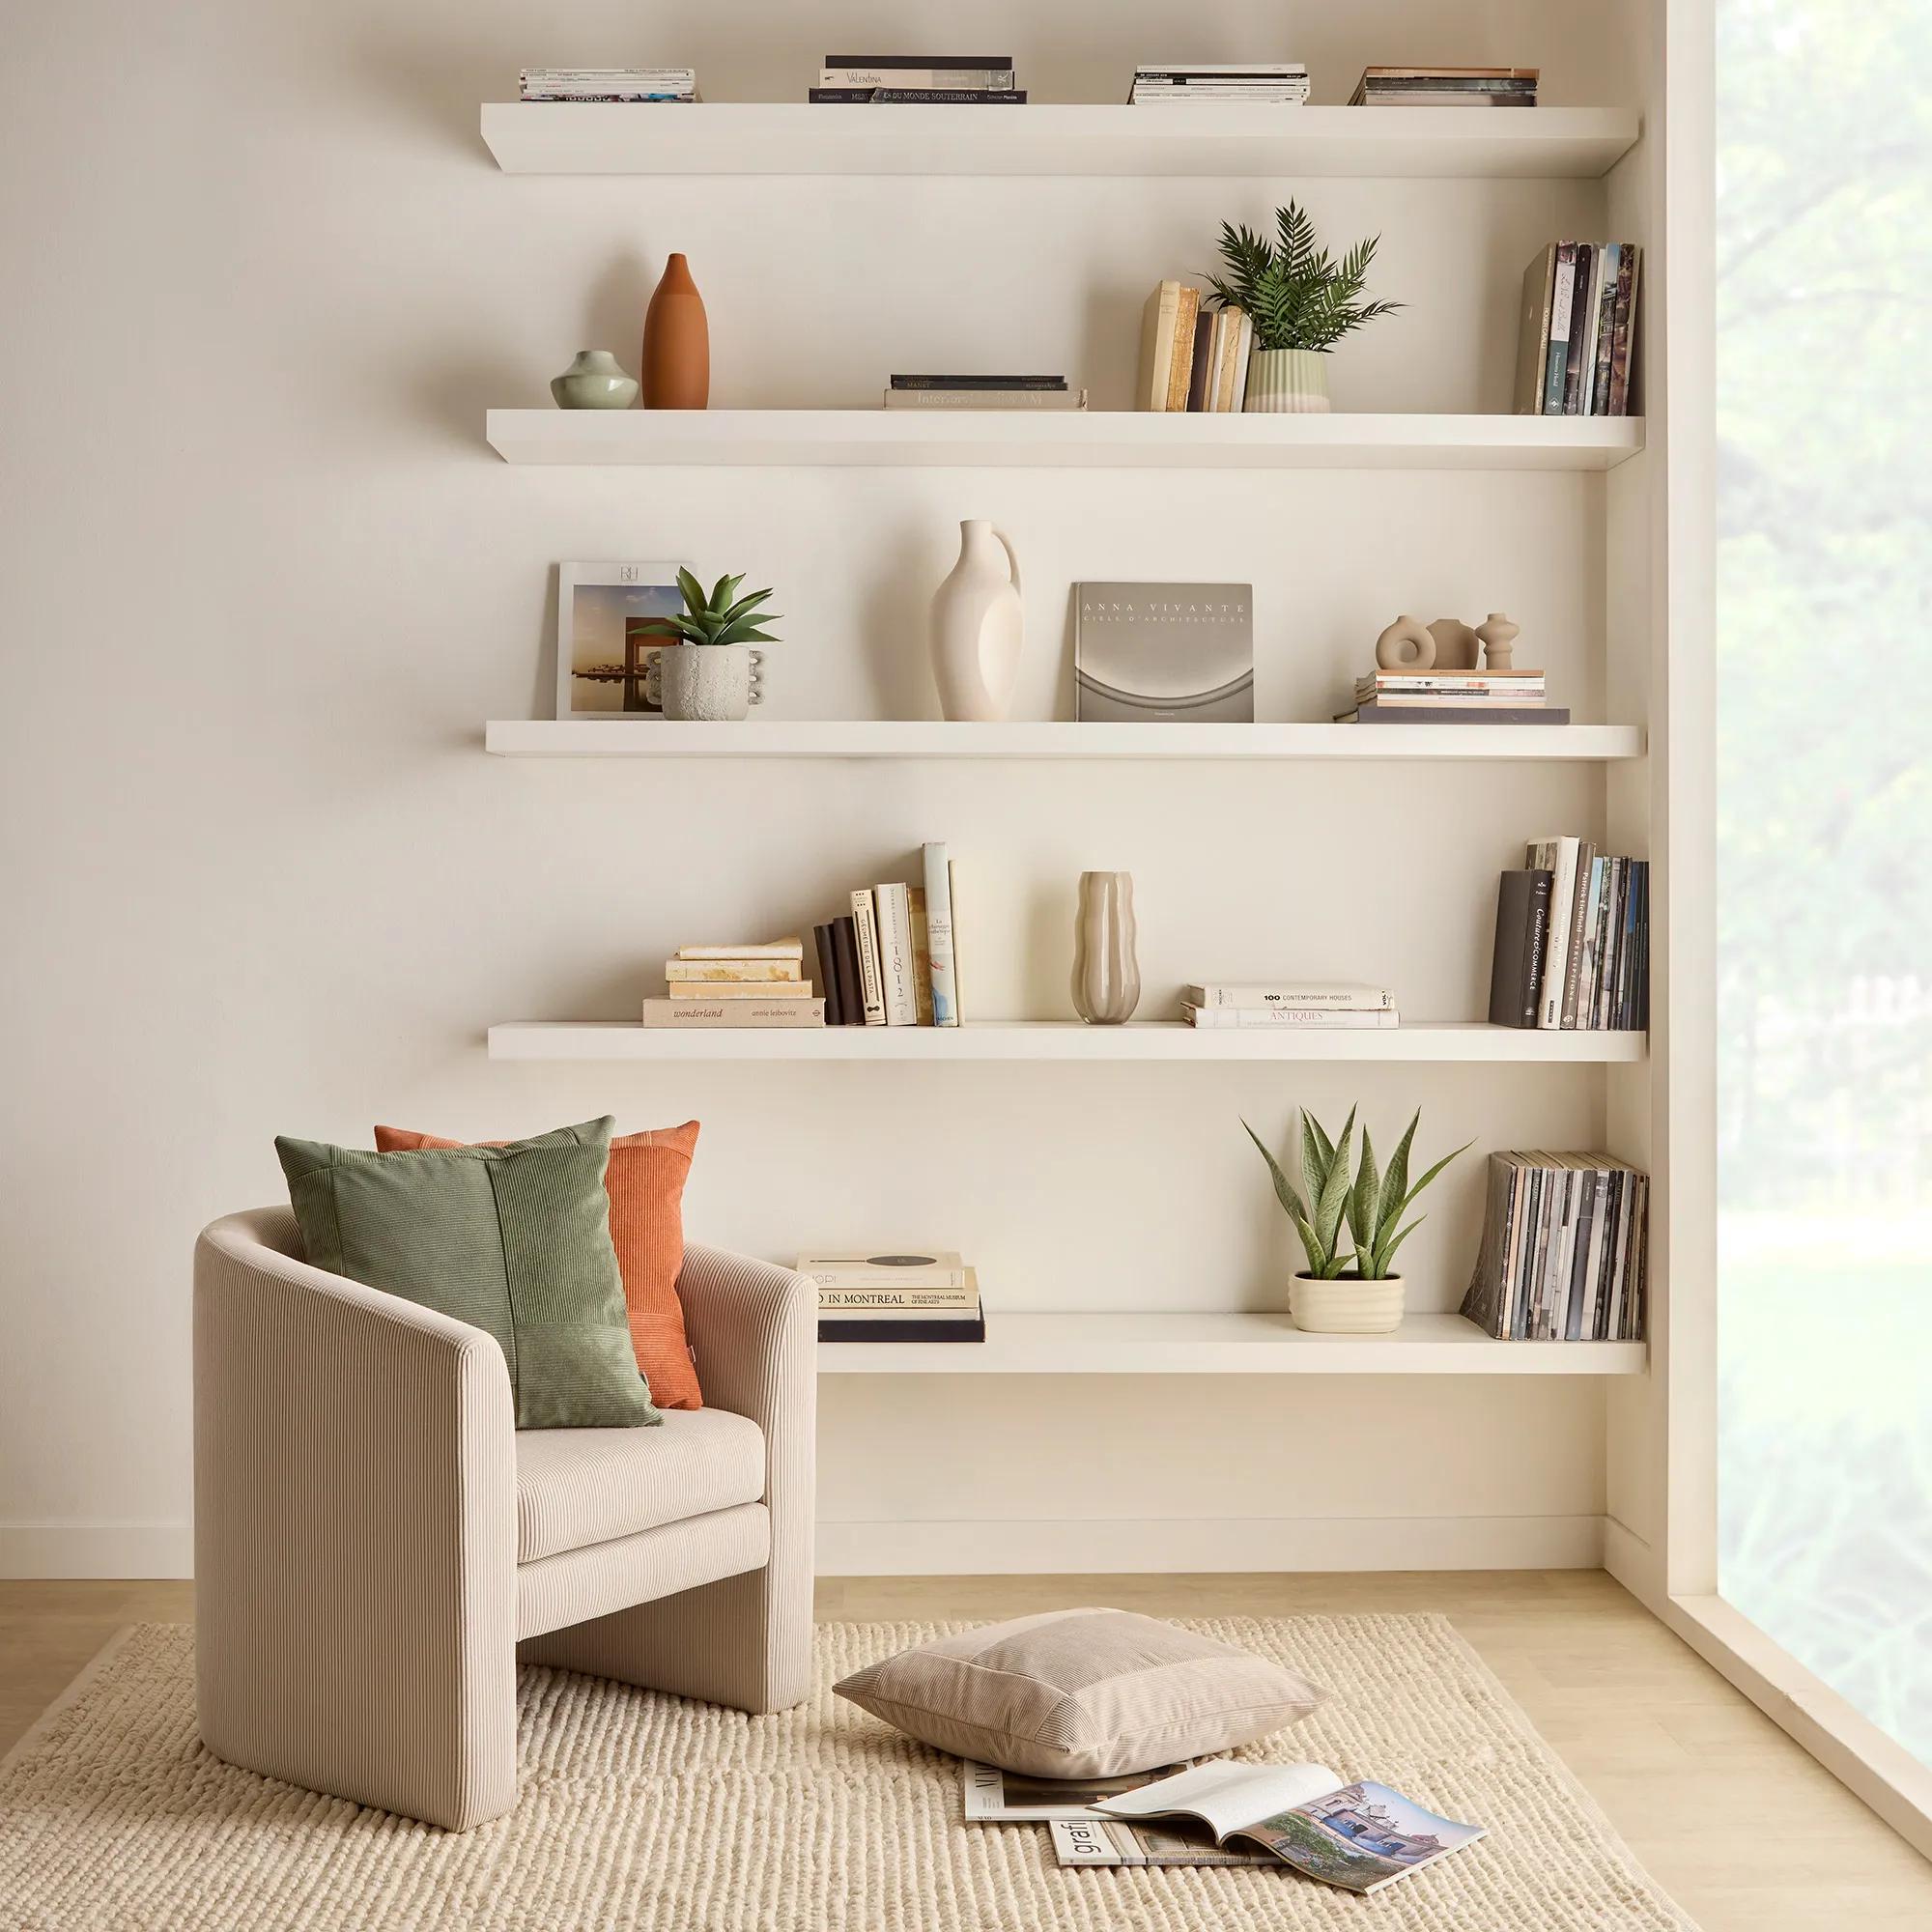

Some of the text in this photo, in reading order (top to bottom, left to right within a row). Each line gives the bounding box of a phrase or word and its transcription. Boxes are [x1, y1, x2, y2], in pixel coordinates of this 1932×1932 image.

[903, 92, 930, 100] MONDE
[931, 92, 979, 100] SOUTERRAIN
[1084, 603, 1244, 612] ANNA VIVANTE
[1579, 871, 1589, 899] Patrick
[1569, 941, 1579, 1001] PERCEPTIONS
[673, 1009, 723, 1018] wonderland
[1270, 1011, 1323, 1021] ANTIQUES
[828, 1293, 840, 1304] IN
[843, 1294, 905, 1304] MONTREAL
